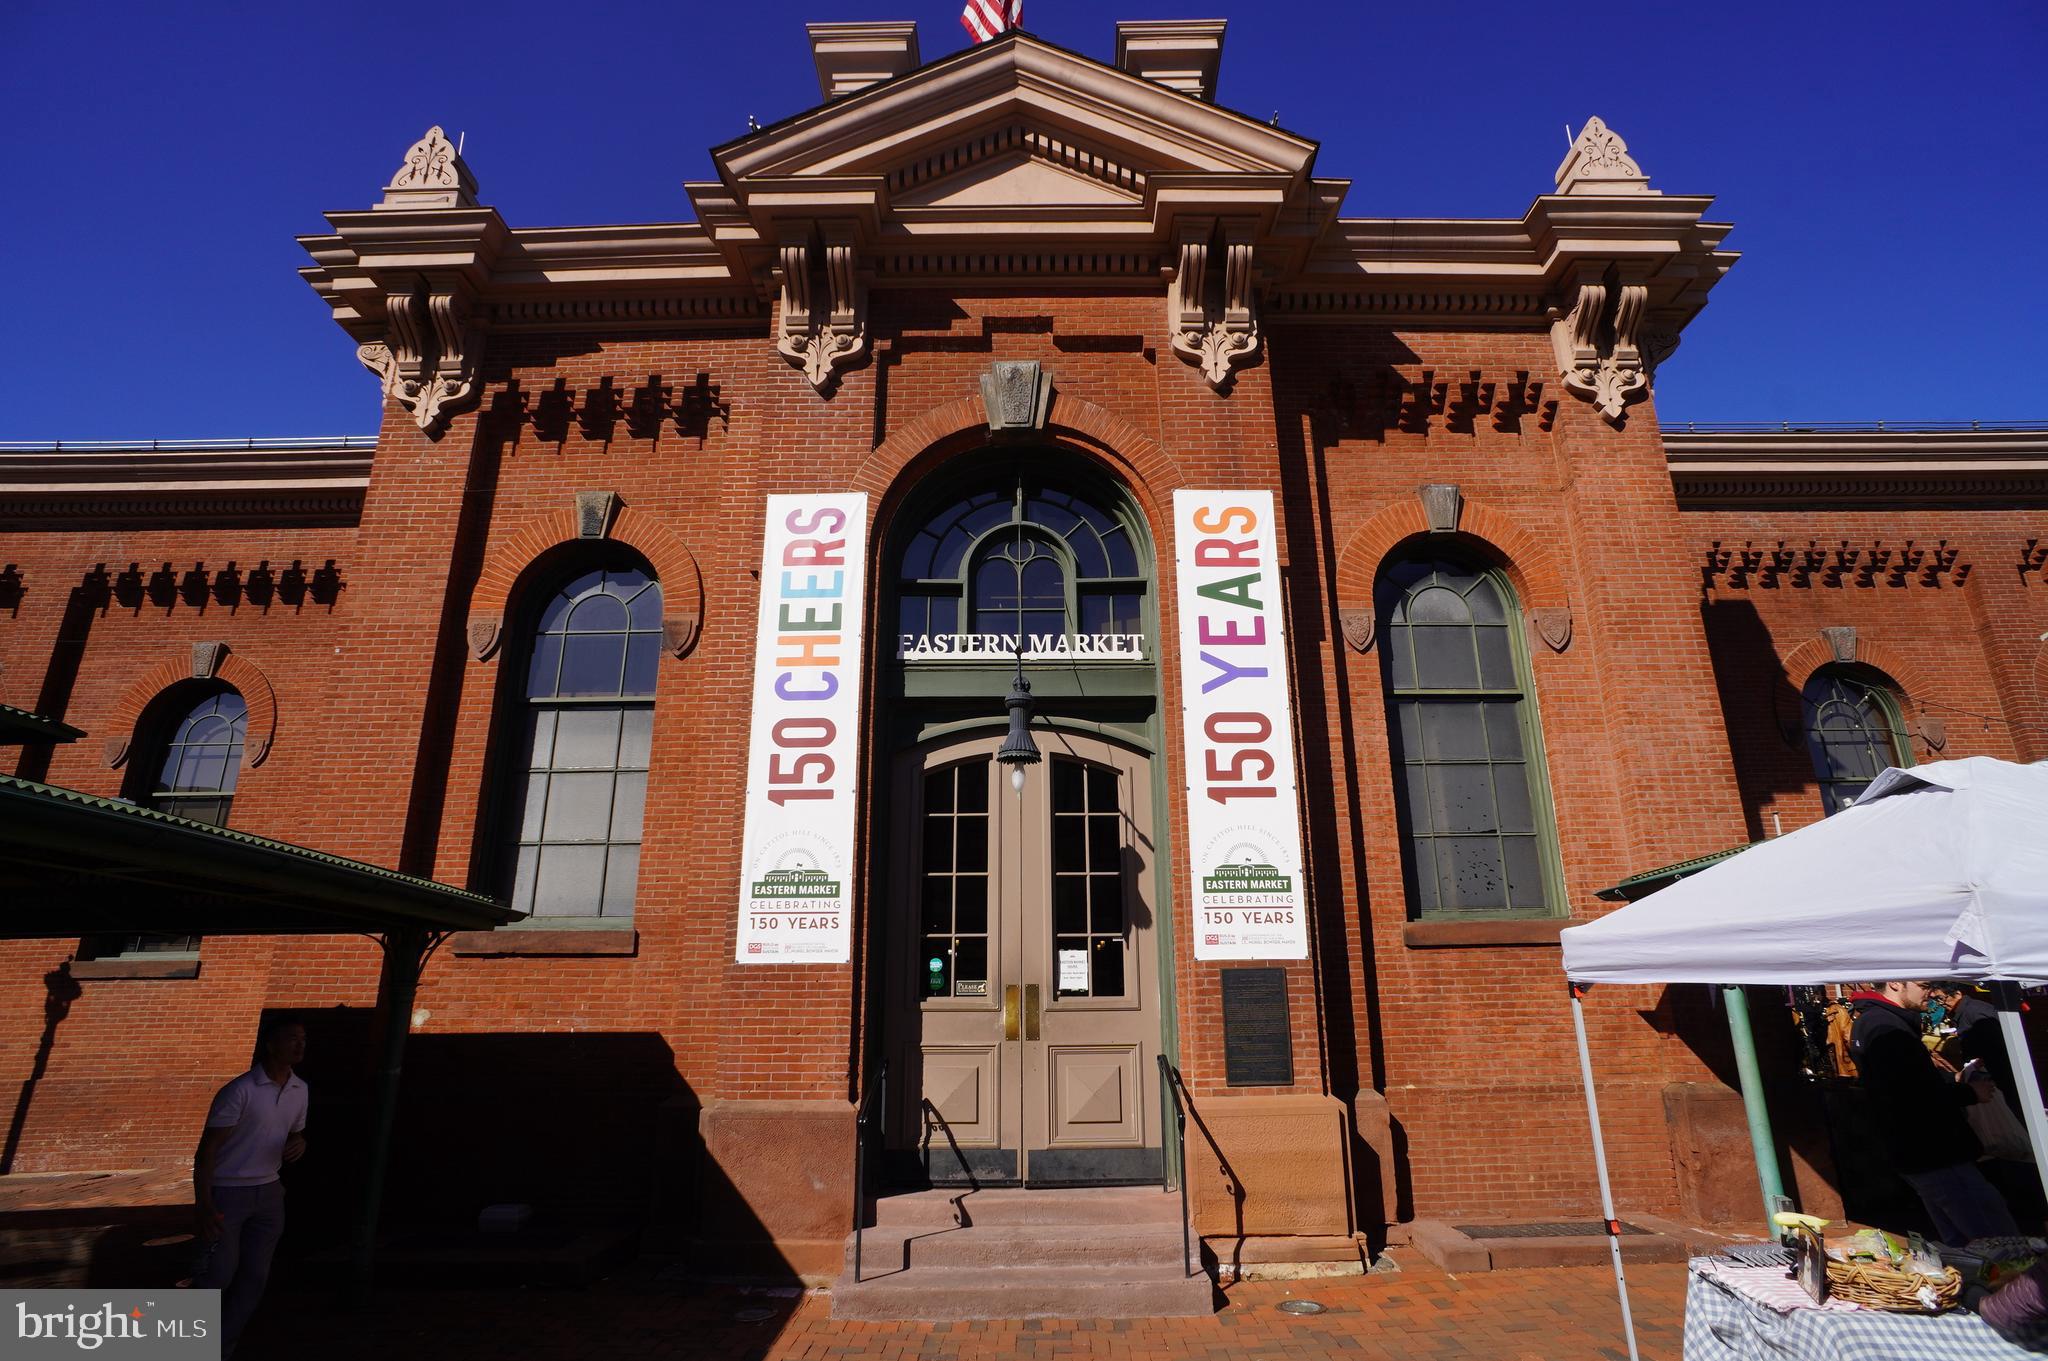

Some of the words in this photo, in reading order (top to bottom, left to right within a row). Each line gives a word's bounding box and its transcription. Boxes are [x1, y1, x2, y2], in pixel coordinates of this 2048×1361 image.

[774, 507, 847, 701] CHEERS
[1193, 506, 1268, 695] YEARS
[897, 633, 1022, 653] EASTERN
[1028, 633, 1145, 653] MARKET
[768, 718, 836, 807] 150
[1204, 711, 1277, 805] 150
[754, 885, 797, 895] EASTERN
[798, 885, 838, 895] MARKET
[1205, 880, 1248, 890] EASTERN
[1250, 879, 1289, 889] MARKET
[749, 900, 841, 909] CELEBRATING
[1202, 895, 1294, 904] CELEBRATING
[750, 917, 779, 930] 150
[788, 917, 840, 930] YEARS
[1204, 912, 1233, 924] 150
[1242, 911, 1294, 924] YEARS
